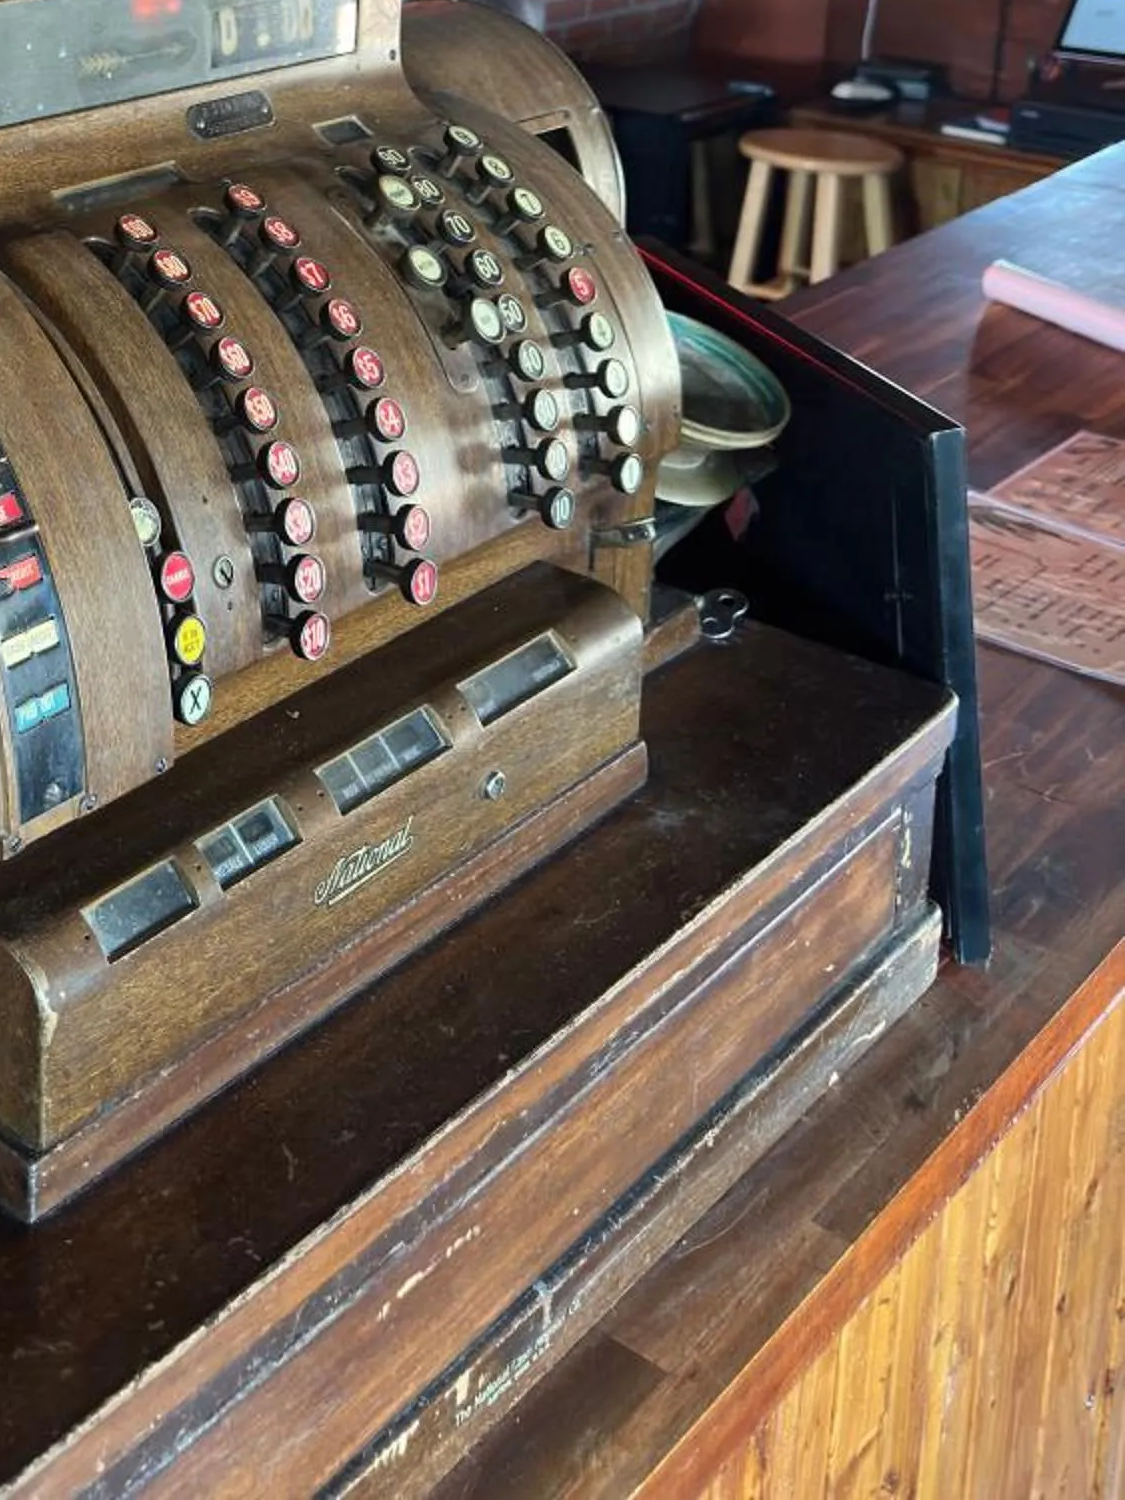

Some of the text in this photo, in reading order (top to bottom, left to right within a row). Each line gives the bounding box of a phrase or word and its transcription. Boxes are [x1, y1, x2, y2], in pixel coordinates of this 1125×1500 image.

[445, 214, 472, 237] 70
[300, 261, 325, 288] $7
[475, 254, 500, 278] 60
[188, 297, 221, 324] $70
[330, 304, 356, 334] $6
[355, 354, 382, 384] $5
[379, 401, 405, 435] $4
[554, 495, 570, 525] 10
[295, 562, 322, 601] $20
[414, 564, 433, 599] $1
[302, 616, 326, 657] $10
[189, 685, 203, 715] X
[314, 814, 414, 905] National
